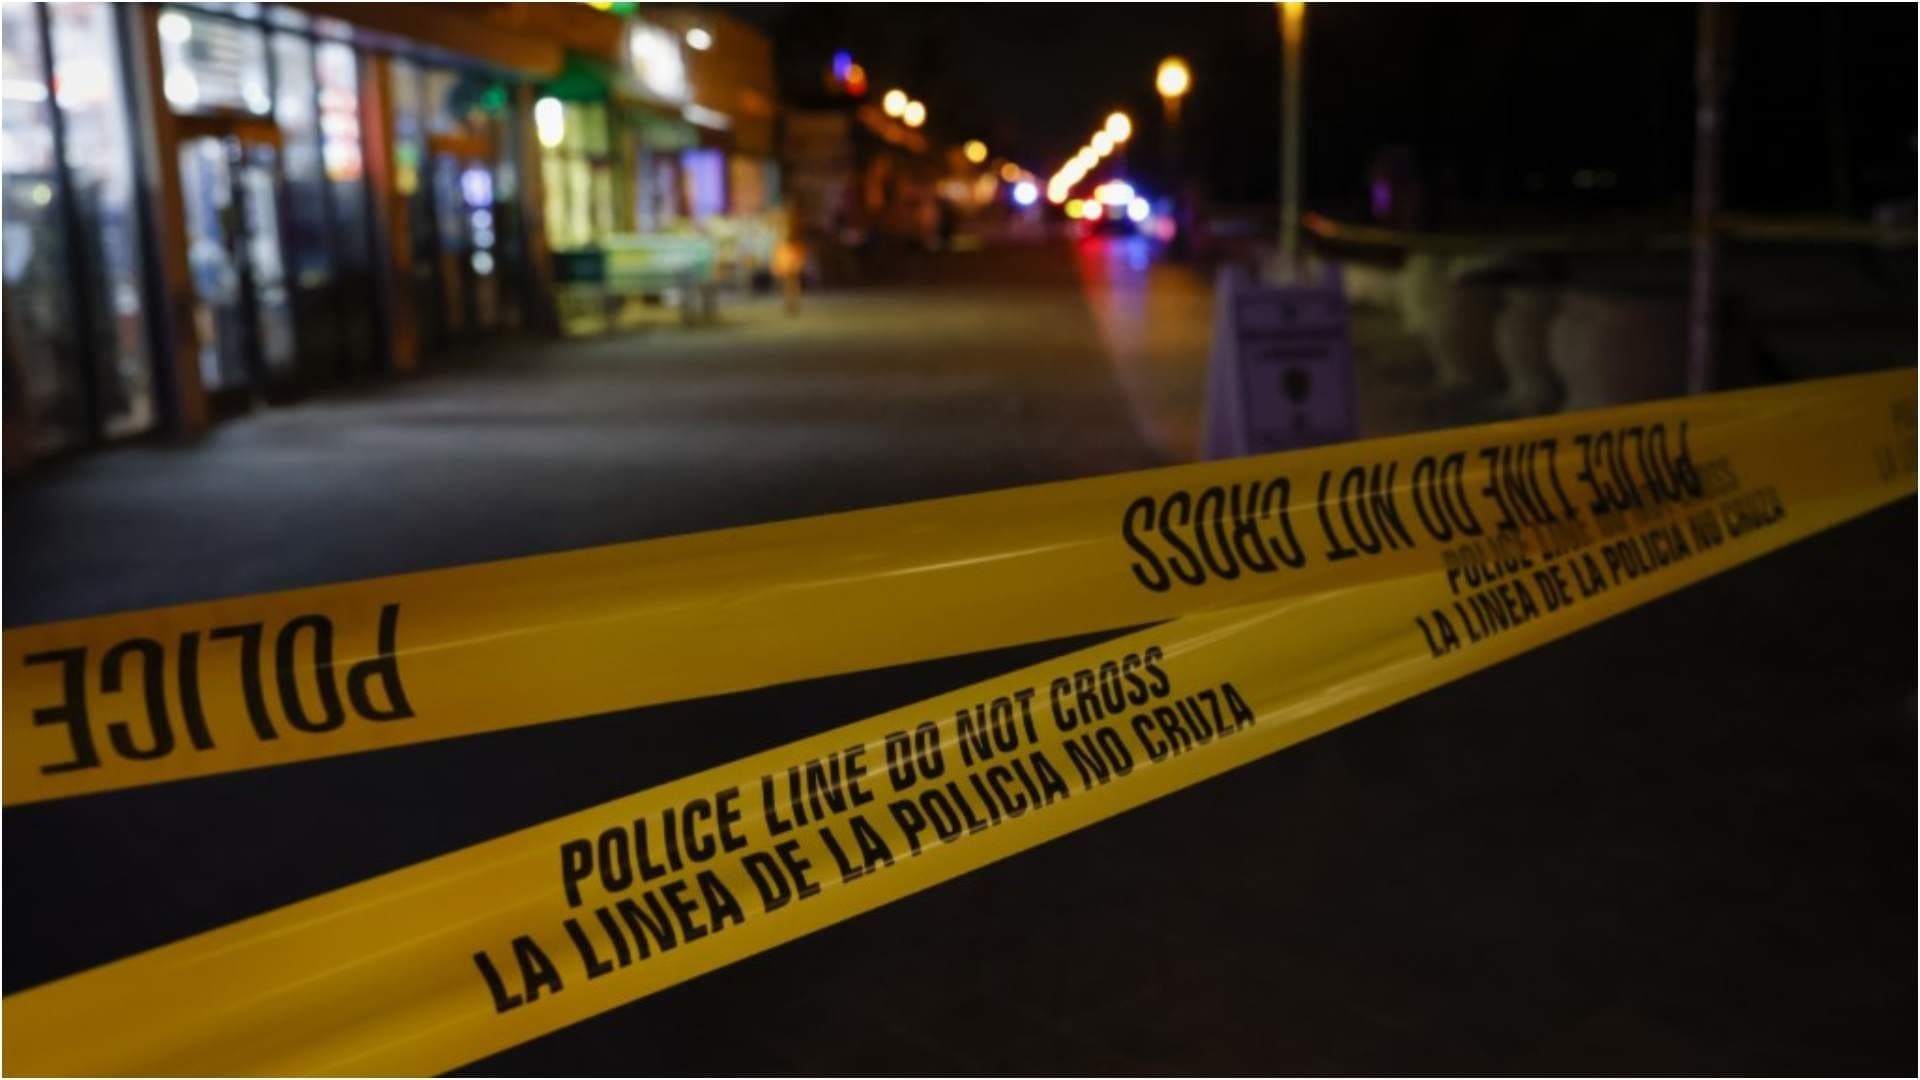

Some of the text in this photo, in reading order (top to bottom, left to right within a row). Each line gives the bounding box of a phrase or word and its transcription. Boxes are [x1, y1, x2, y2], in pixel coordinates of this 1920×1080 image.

[1121, 420, 1704, 593] POLICE LINE DO NOT CROSS
[1414, 608, 1461, 657] LA
[1453, 578, 1540, 642] LINEA
[1534, 564, 1574, 613] DE
[1569, 553, 1609, 600] LA
[1603, 525, 1692, 586] POLICIA
[22, 603, 416, 776] POLICE
[472, 681, 1255, 1014] LA LINEA DE LA POLICIA NO CRUZA
[560, 645, 1171, 909] POLICE LINE DO NOT CROSS
